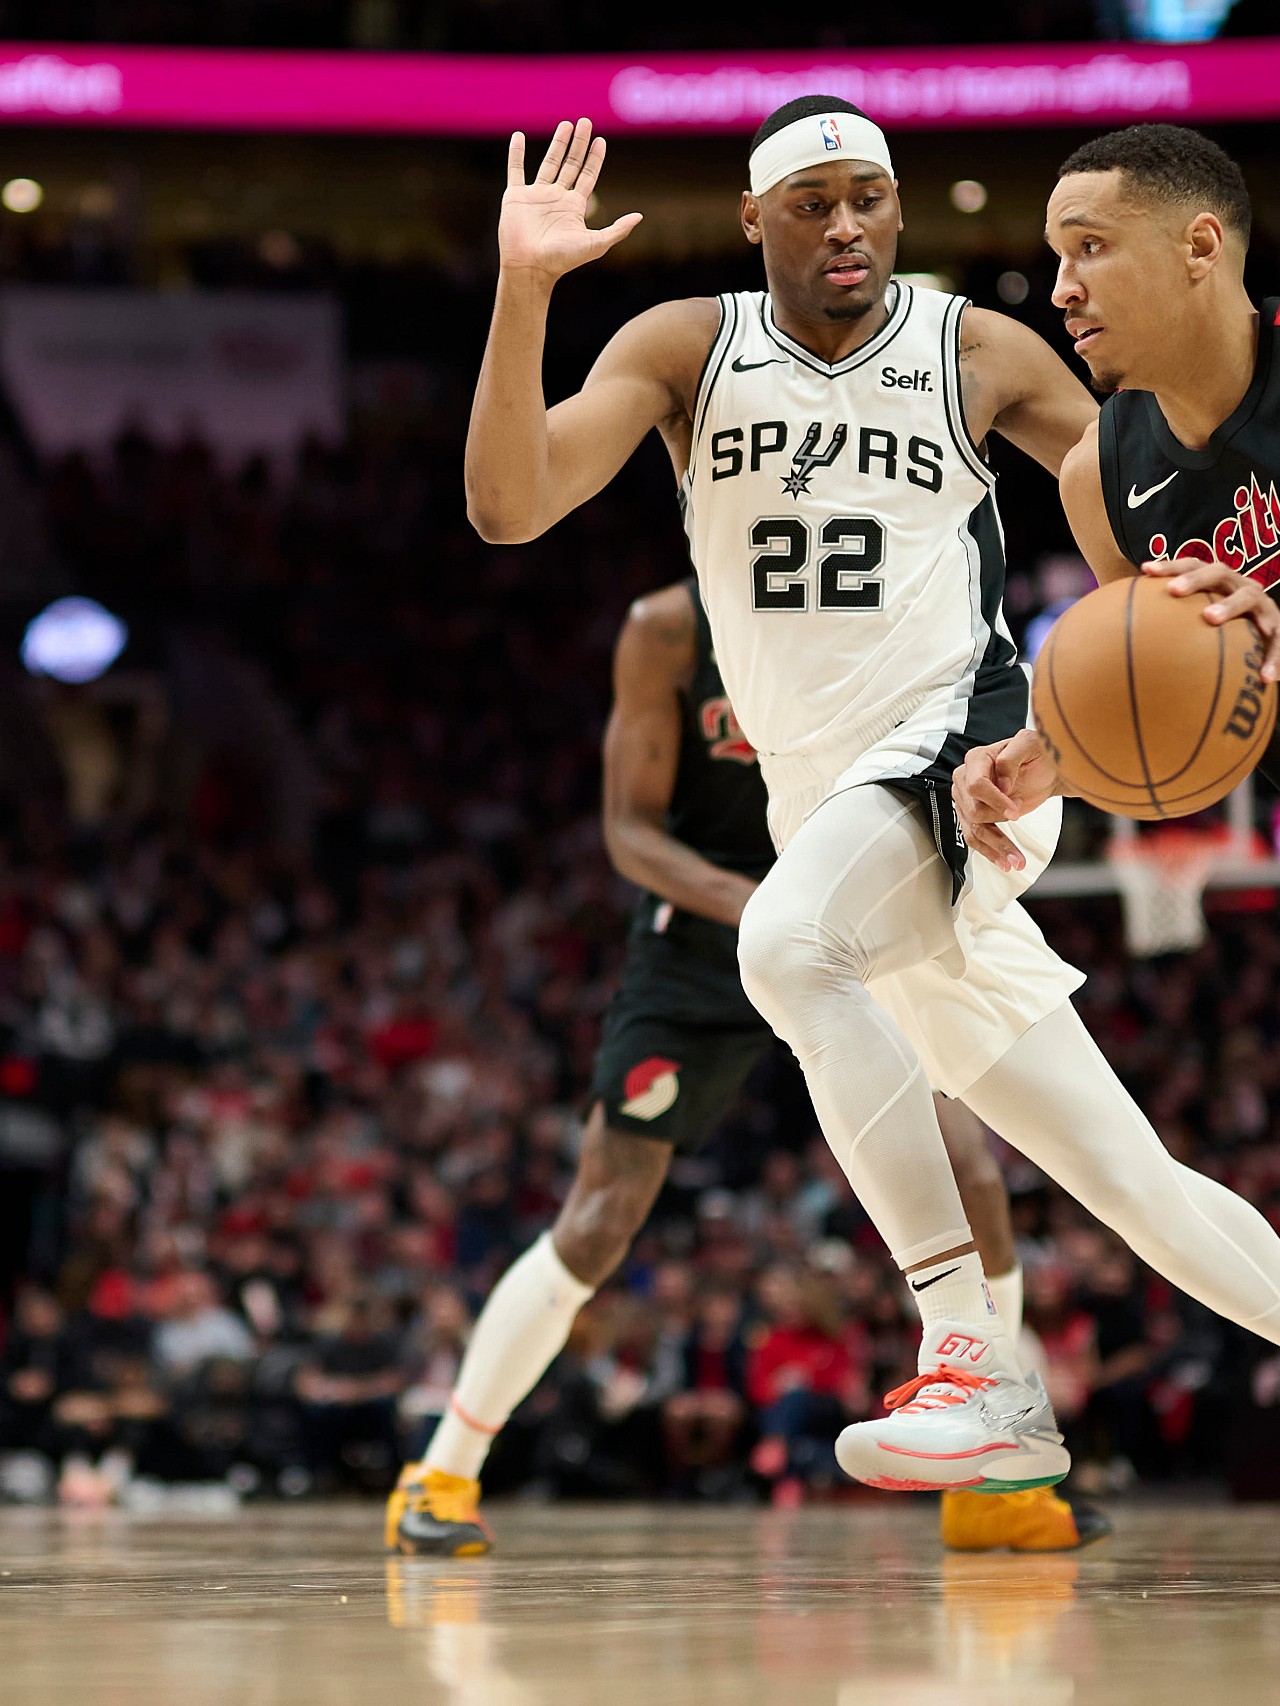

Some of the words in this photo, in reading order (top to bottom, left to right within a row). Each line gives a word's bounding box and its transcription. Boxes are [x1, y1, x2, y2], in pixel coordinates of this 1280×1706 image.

[608, 65, 743, 124] Good
[880, 366, 934, 393] Self.
[748, 514, 887, 613] 22
